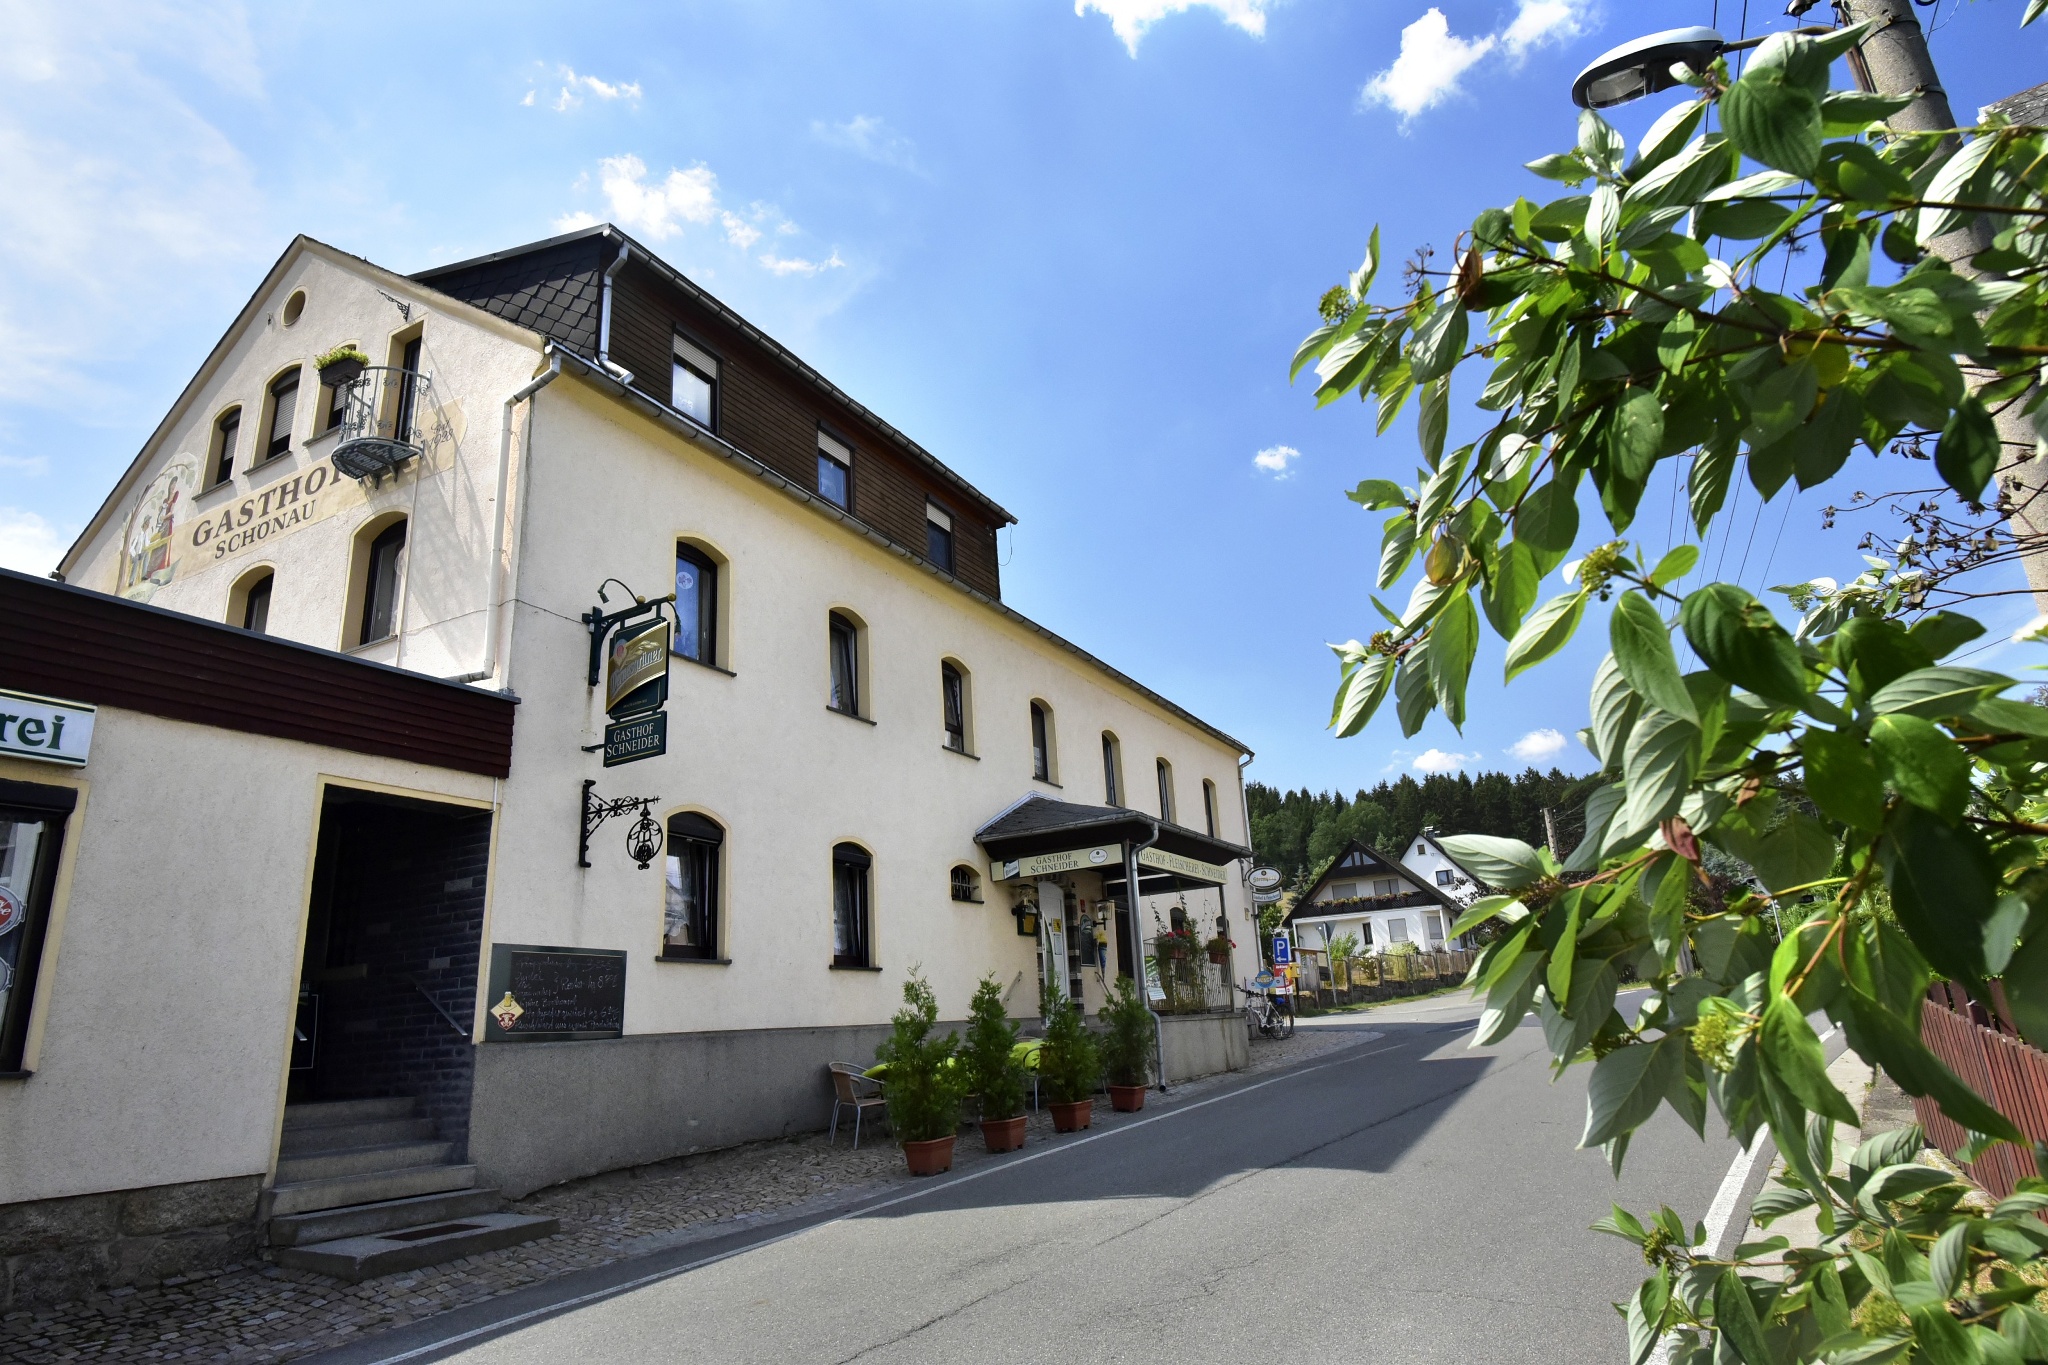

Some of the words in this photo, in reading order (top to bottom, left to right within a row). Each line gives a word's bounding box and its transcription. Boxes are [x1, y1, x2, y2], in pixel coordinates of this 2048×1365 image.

[214, 500, 316, 559] SCHÖNAU
[0, 713, 66, 750] rei
[613, 722, 655, 742] GASTHOF
[606, 734, 660, 758] SCHNEIDER
[1030, 860, 1079, 874] SCHNEIDER
[1035, 853, 1072, 865] GASTHOF
[1140, 849, 1166, 865] GASTHOF
[1201, 863, 1227, 881] SCHNEIDER
[1276, 941, 1285, 955] P
